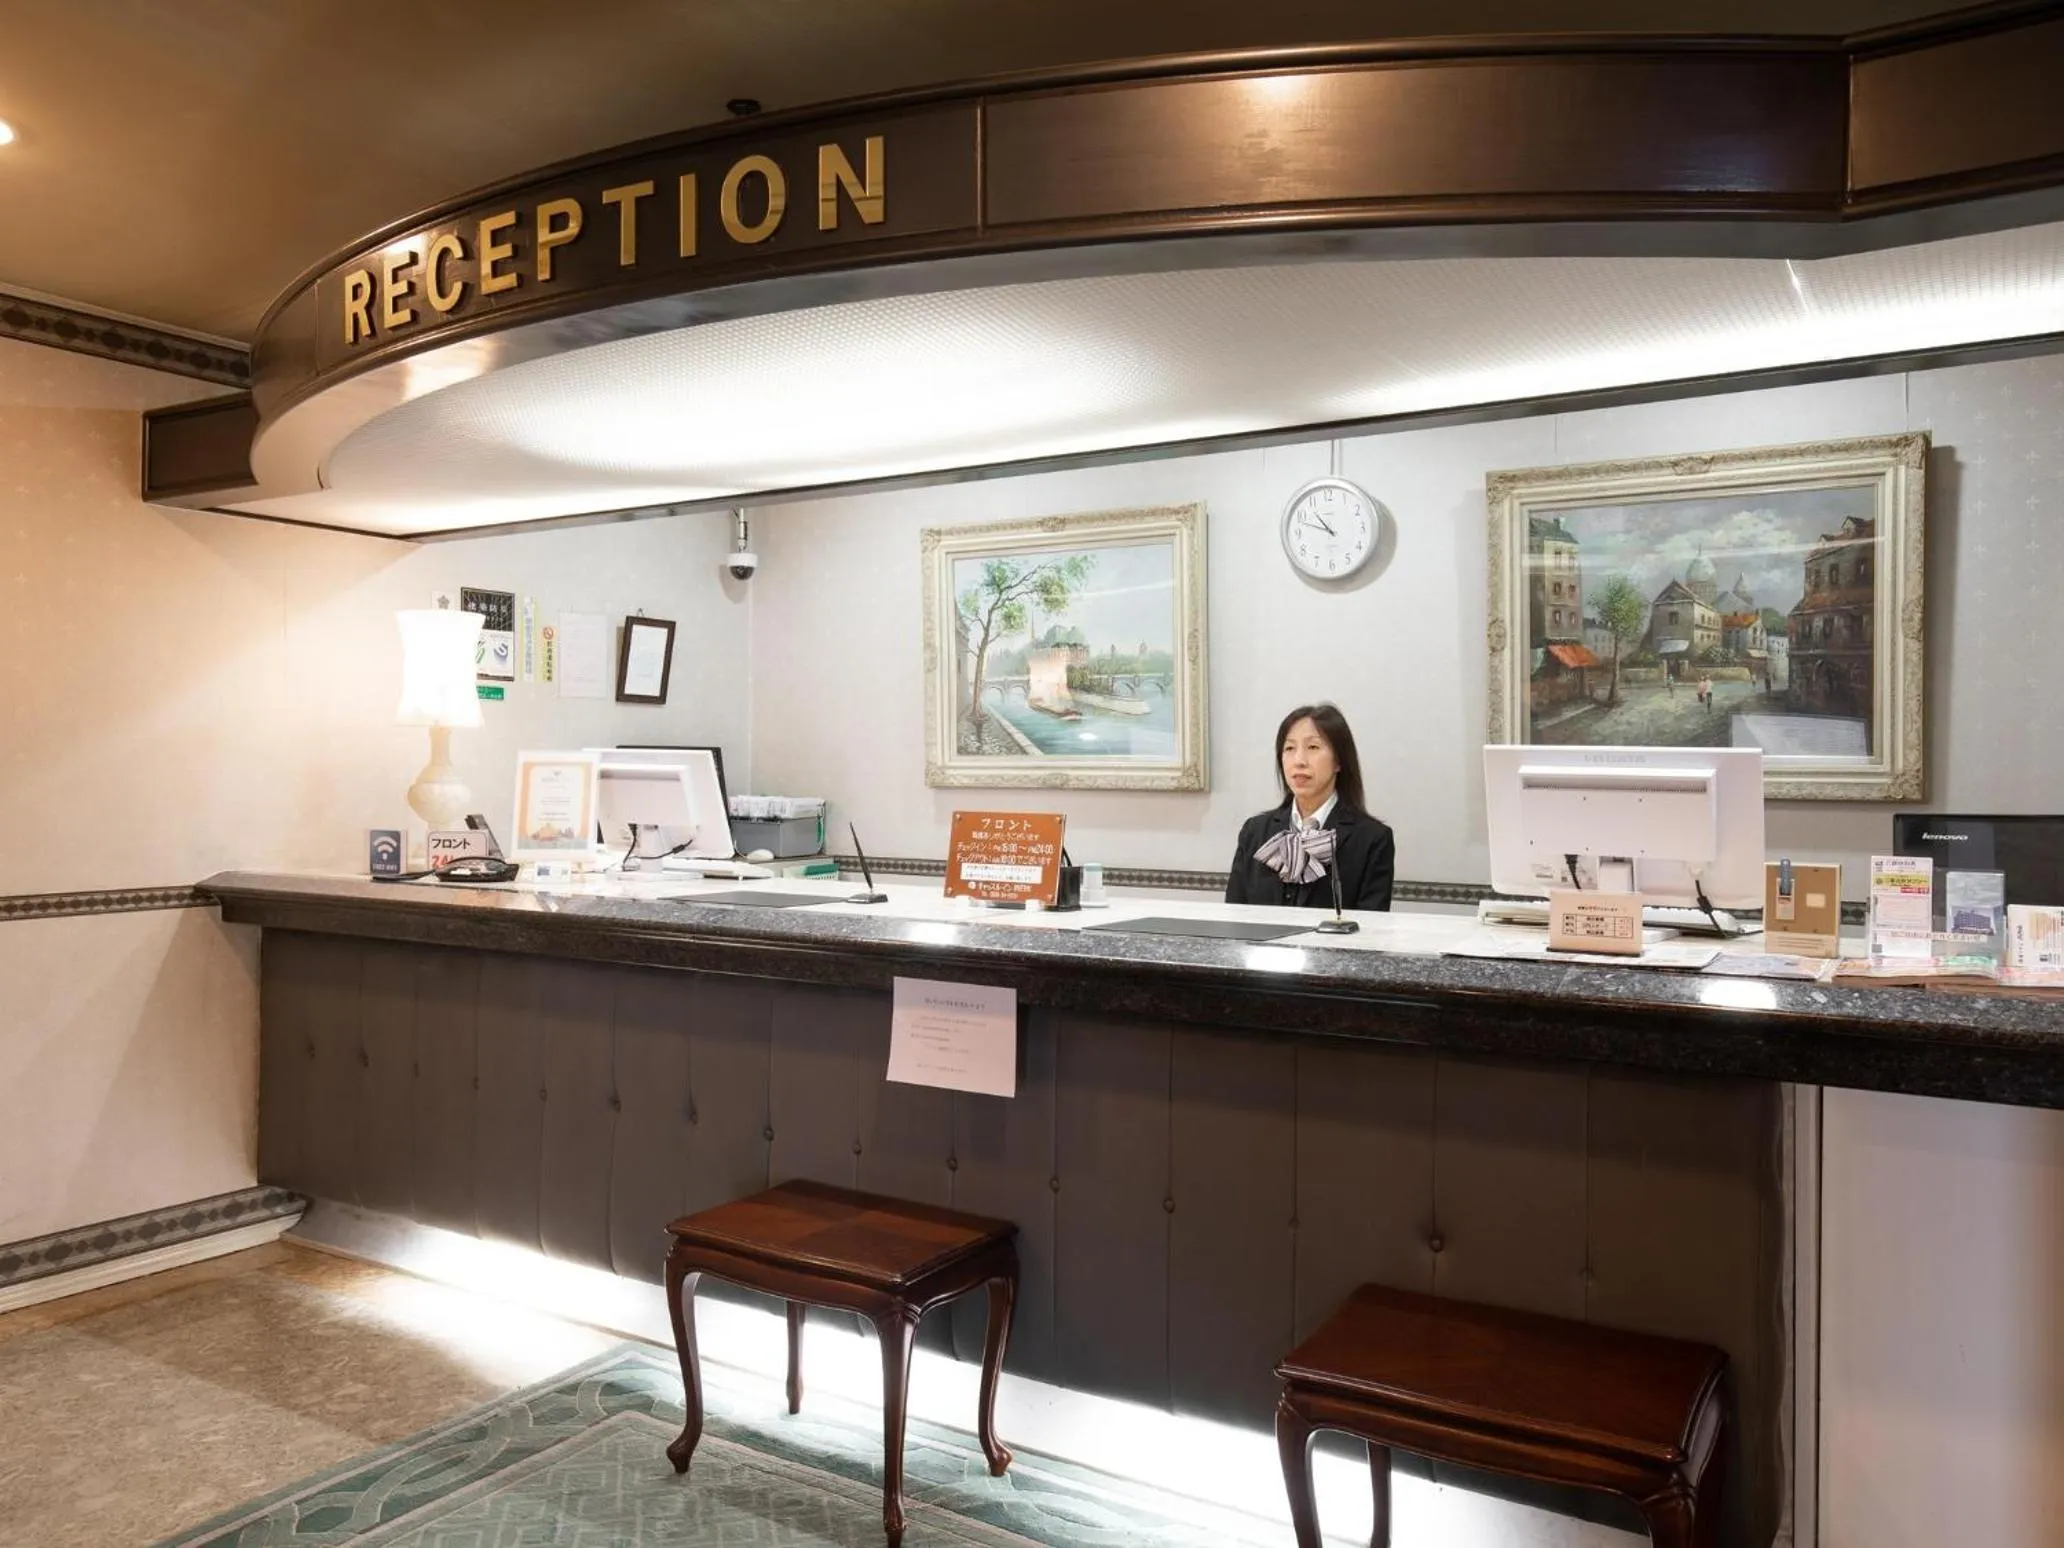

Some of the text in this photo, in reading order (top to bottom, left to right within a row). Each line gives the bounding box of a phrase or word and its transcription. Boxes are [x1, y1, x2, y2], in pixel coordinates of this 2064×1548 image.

[343, 135, 886, 345] RECEPTION
[1309, 495, 1317, 507] 11
[1323, 489, 1333, 501] 12
[1354, 504, 1360, 516] 2
[1295, 528, 1301, 539] 9
[1361, 522, 1366, 533] 3
[1300, 544, 1306, 556] 8
[1356, 541, 1362, 552] 4
[1314, 556, 1320, 568] 7
[1329, 559, 1336, 571] 6
[1345, 553, 1351, 565] 5
[981, 818, 1032, 831] フロント
[1921, 831, 1969, 841] lenovo
[431, 838, 471, 850] フロント
